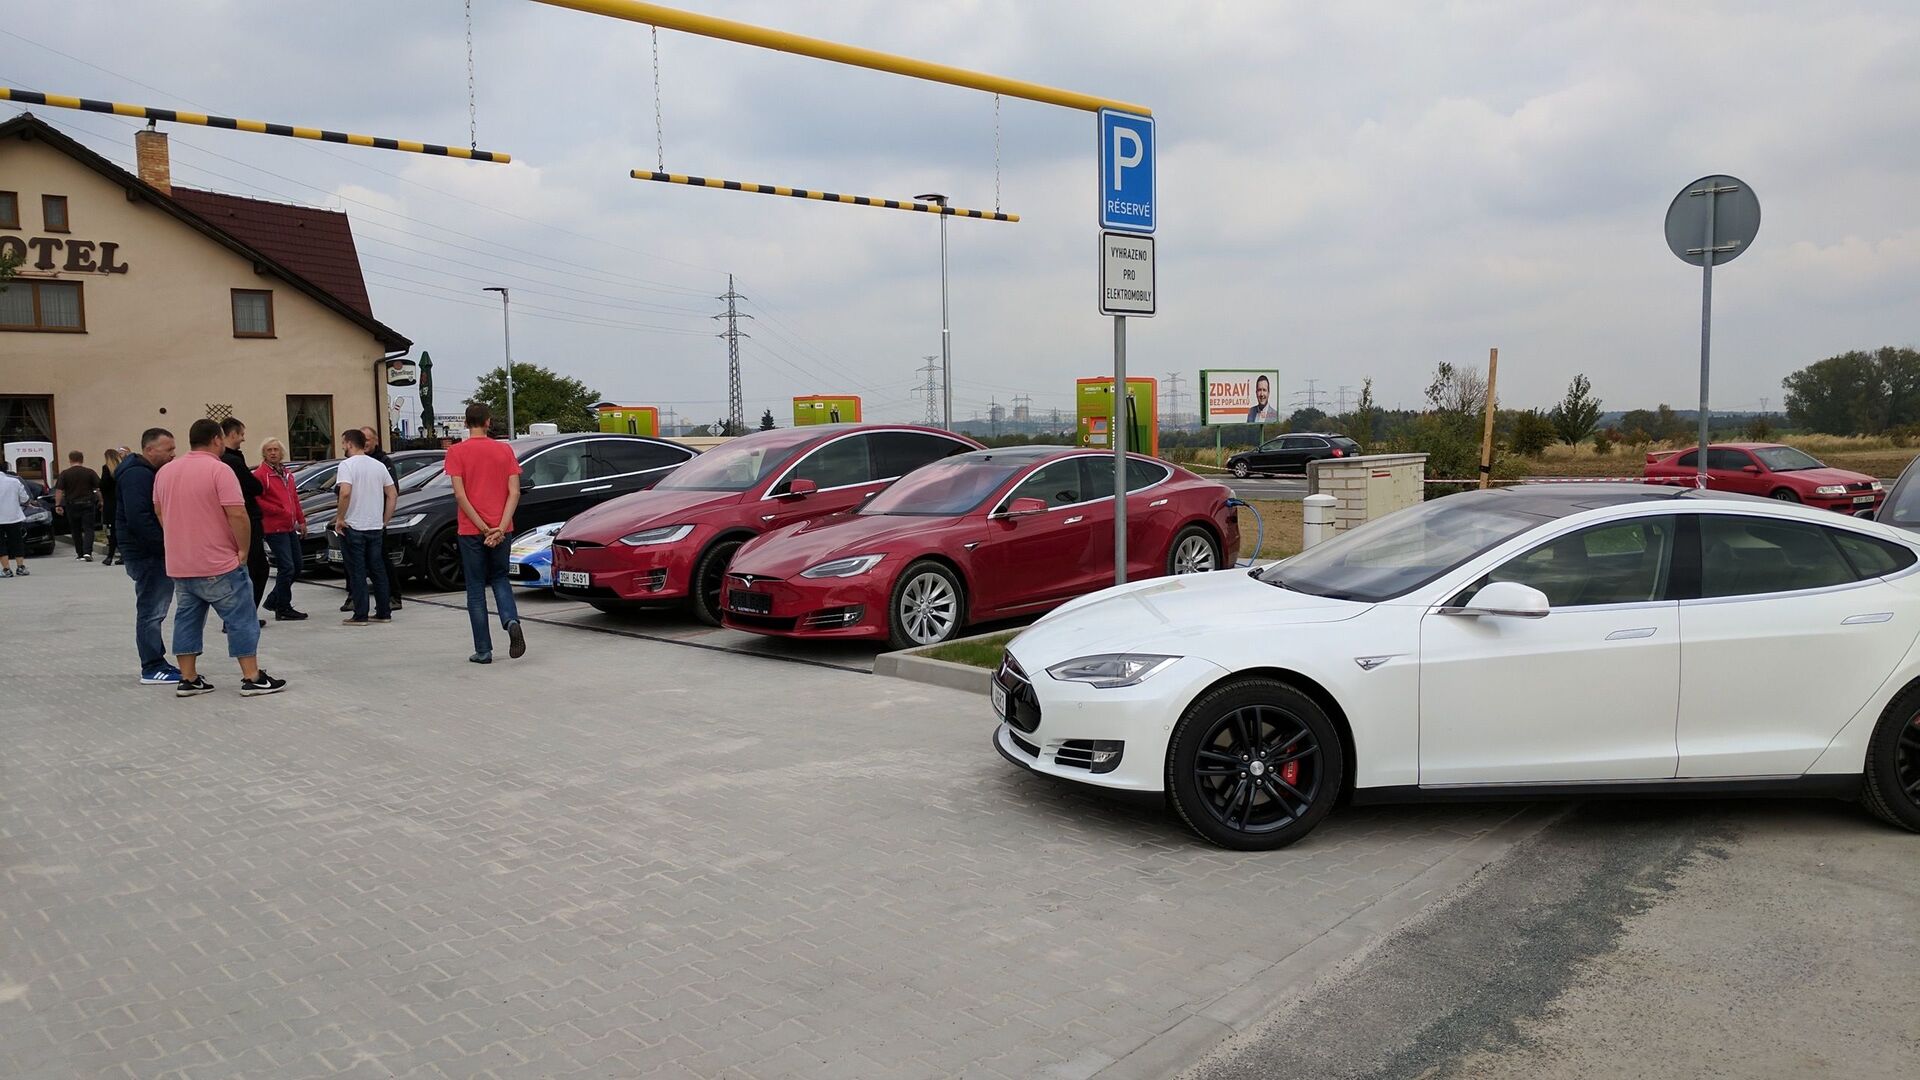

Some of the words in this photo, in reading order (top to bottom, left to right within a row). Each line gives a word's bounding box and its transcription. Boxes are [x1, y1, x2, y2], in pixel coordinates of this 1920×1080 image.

[1113, 125, 1143, 191] P
[1107, 198, 1150, 217] RÉSERVÉ
[1110, 246, 1147, 261] VYHRAZENO
[1123, 268, 1136, 281] PRO
[1106, 287, 1151, 302] ELEKTROMOBILY
[1209, 379, 1250, 397] ZDRAVÍ
[1209, 398, 1221, 406] BEZ
